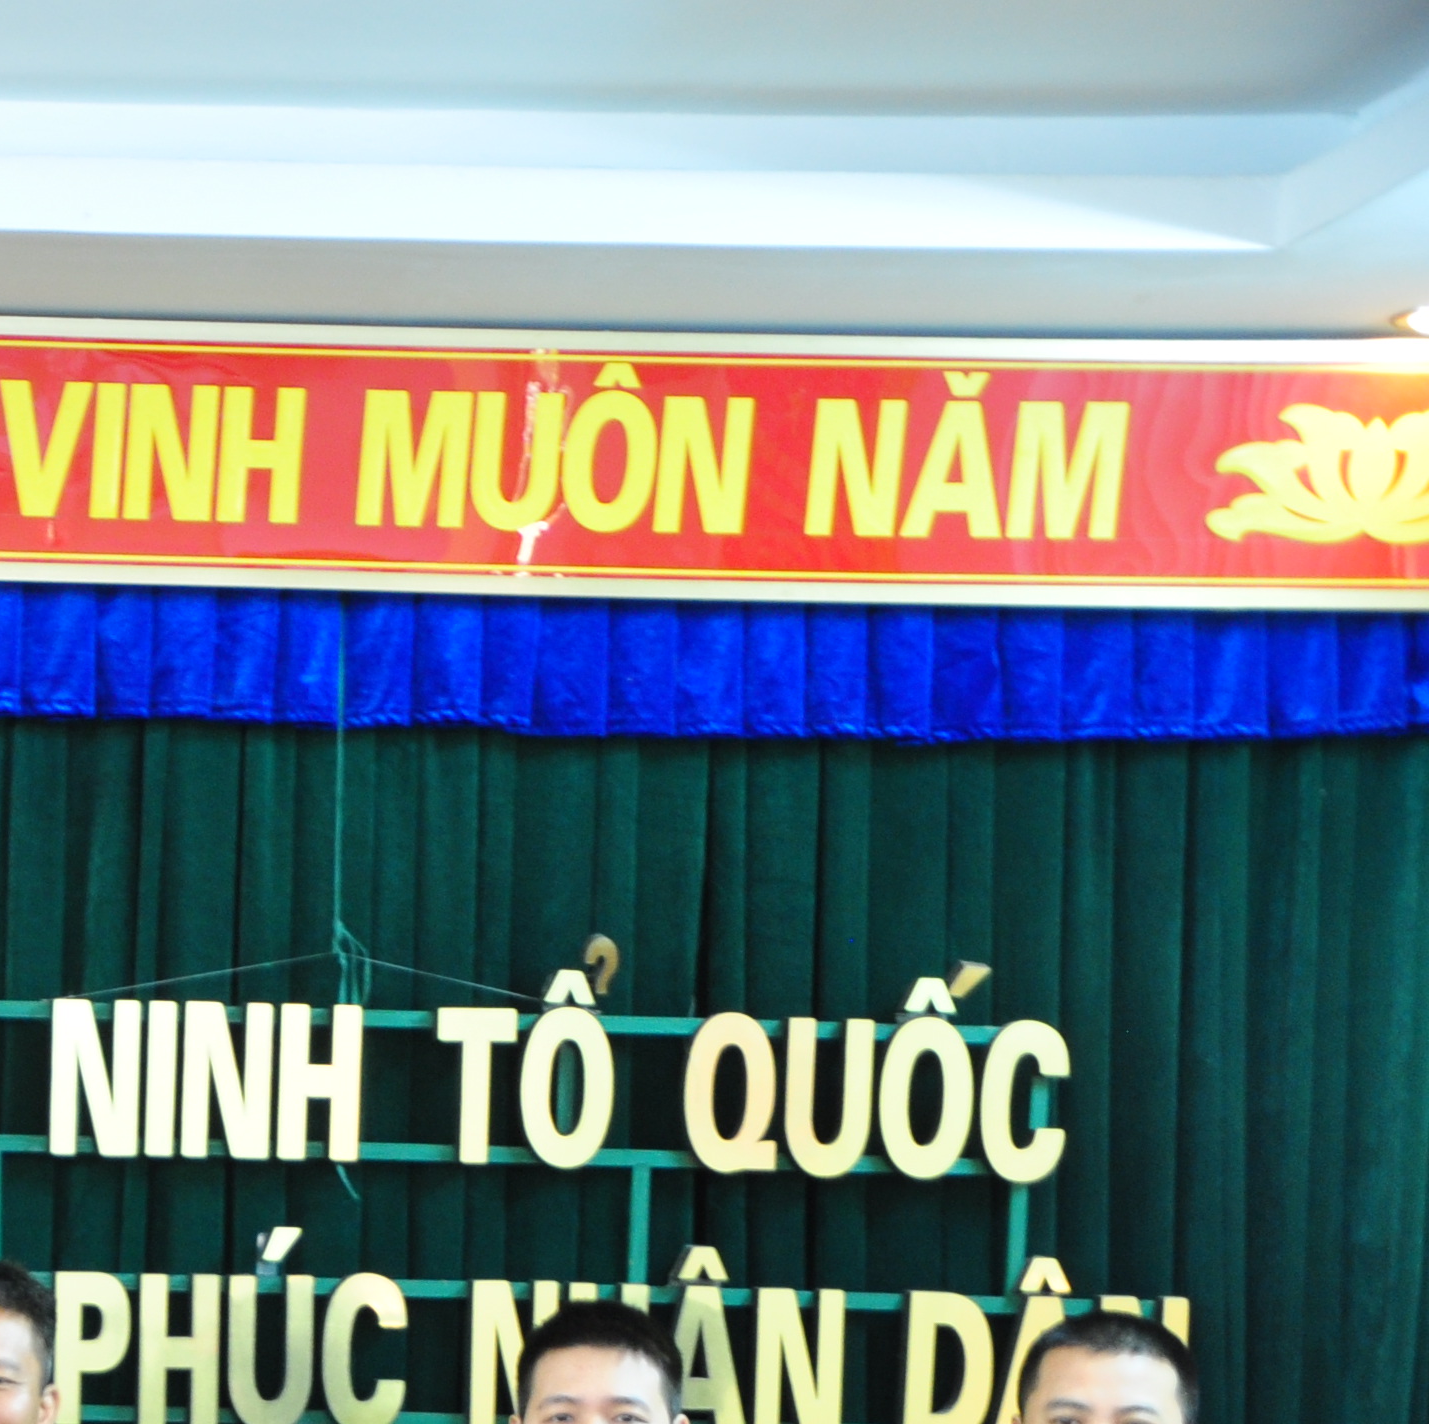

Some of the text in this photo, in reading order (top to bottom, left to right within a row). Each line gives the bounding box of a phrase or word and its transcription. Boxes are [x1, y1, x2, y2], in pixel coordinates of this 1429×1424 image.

[0, 379, 306, 525] VINH
[354, 362, 755, 537] MUÔN
[804, 371, 1130, 541] NĂM
[49, 998, 363, 1163] NINH
[436, 935, 620, 1169] TỔ
[684, 960, 1071, 1183] QUỐC
